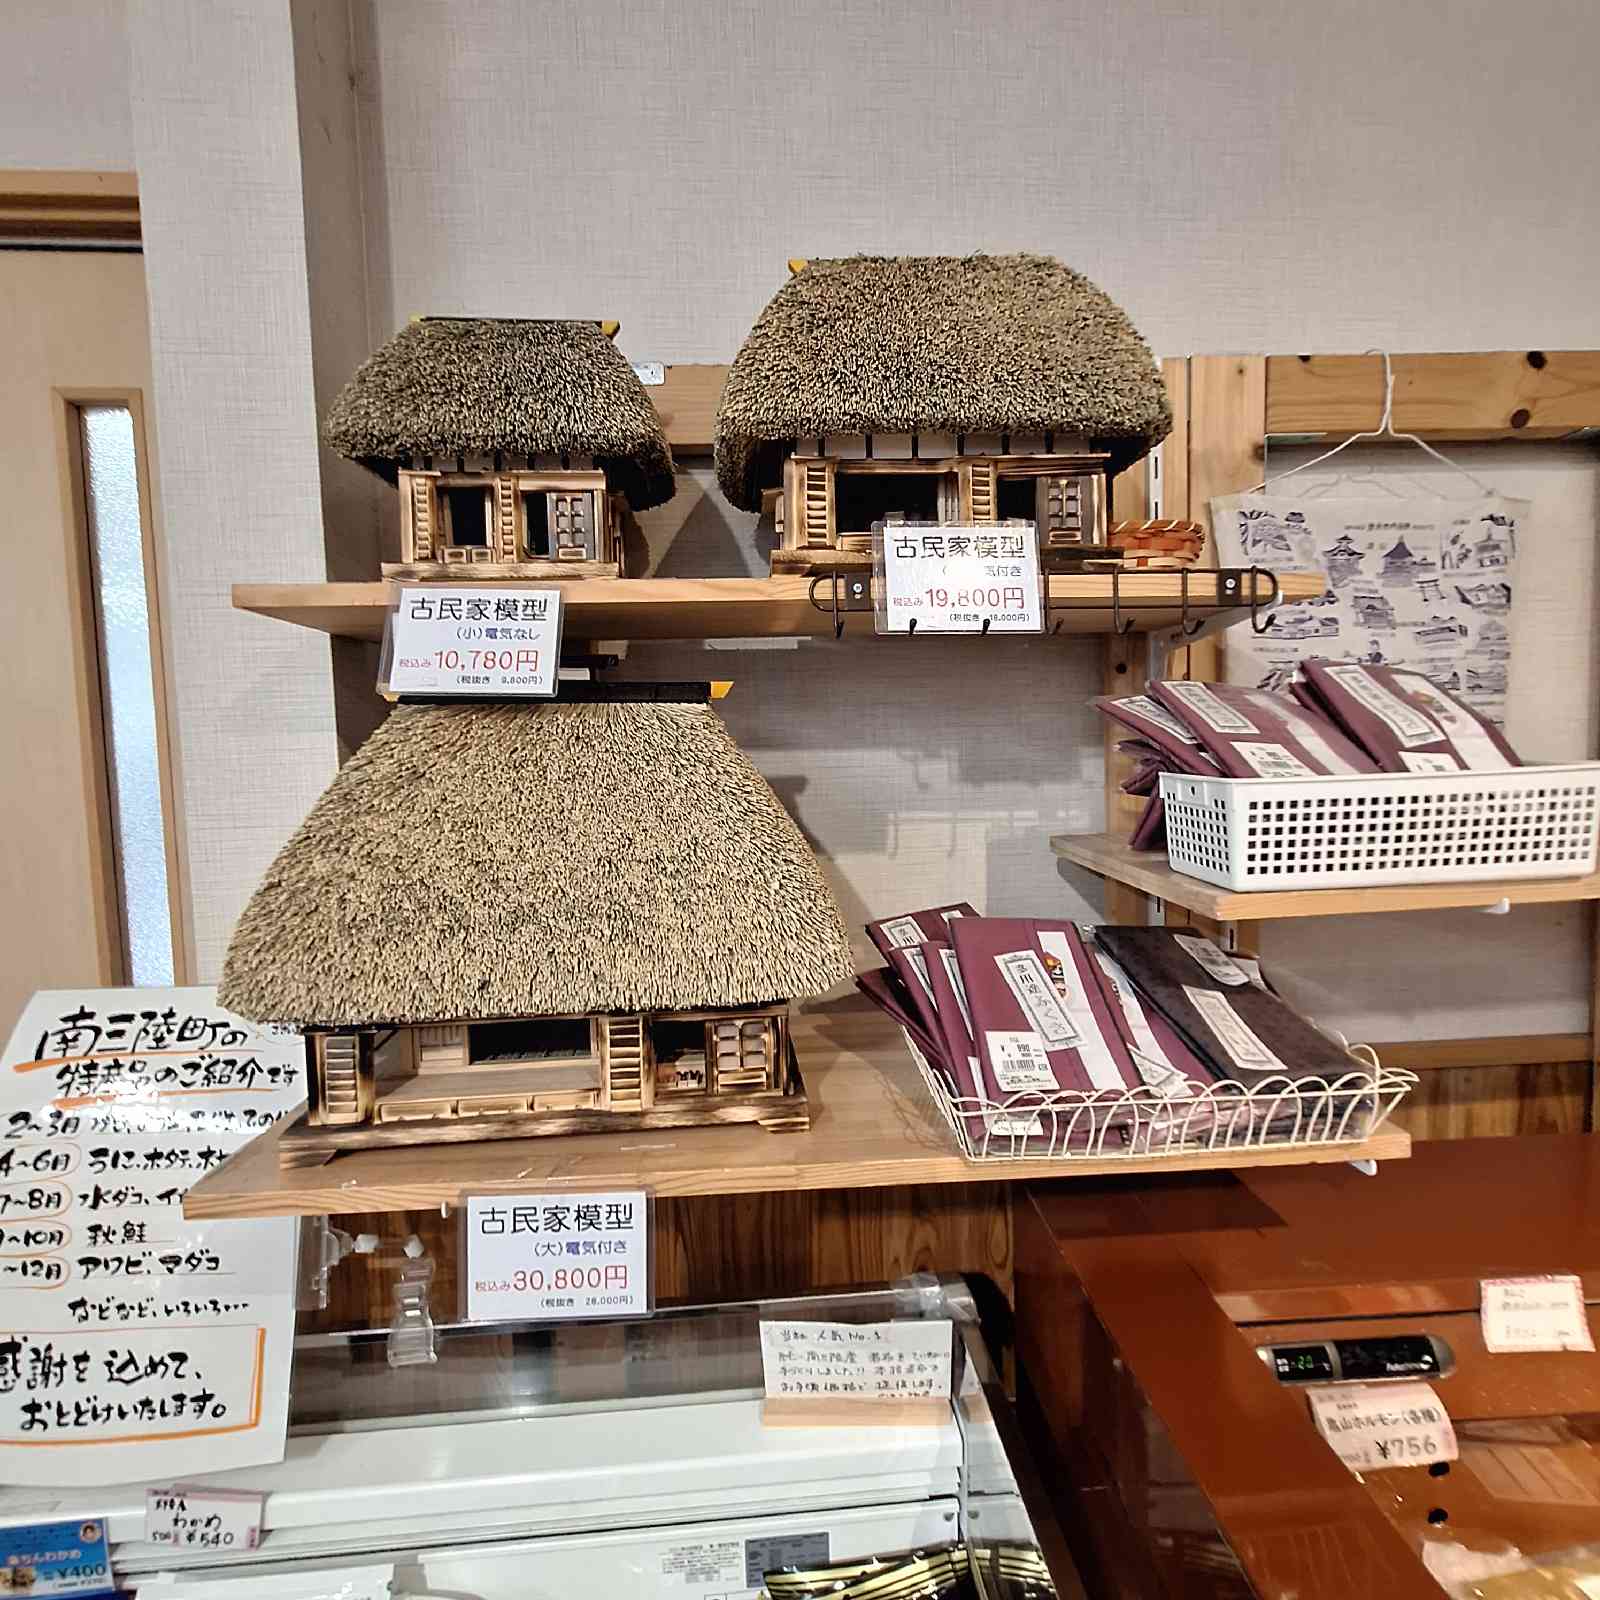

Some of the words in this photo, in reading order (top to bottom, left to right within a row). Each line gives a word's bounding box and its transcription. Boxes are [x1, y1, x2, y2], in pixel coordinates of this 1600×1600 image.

[893, 535, 1026, 559] 古民家模型
[410, 597, 547, 621] 古民家模型
[456, 627, 541, 640] (小)電気なし
[434, 649, 539, 672] 10,780円
[34, 1005, 248, 1061] 南三陸町の
[479, 1202, 633, 1234] 古民家模型
[534, 1241, 628, 1256] (大)電気付き
[513, 1265, 627, 1291] 30,800円
[20, 1388, 227, 1431] おとどけいたします。
